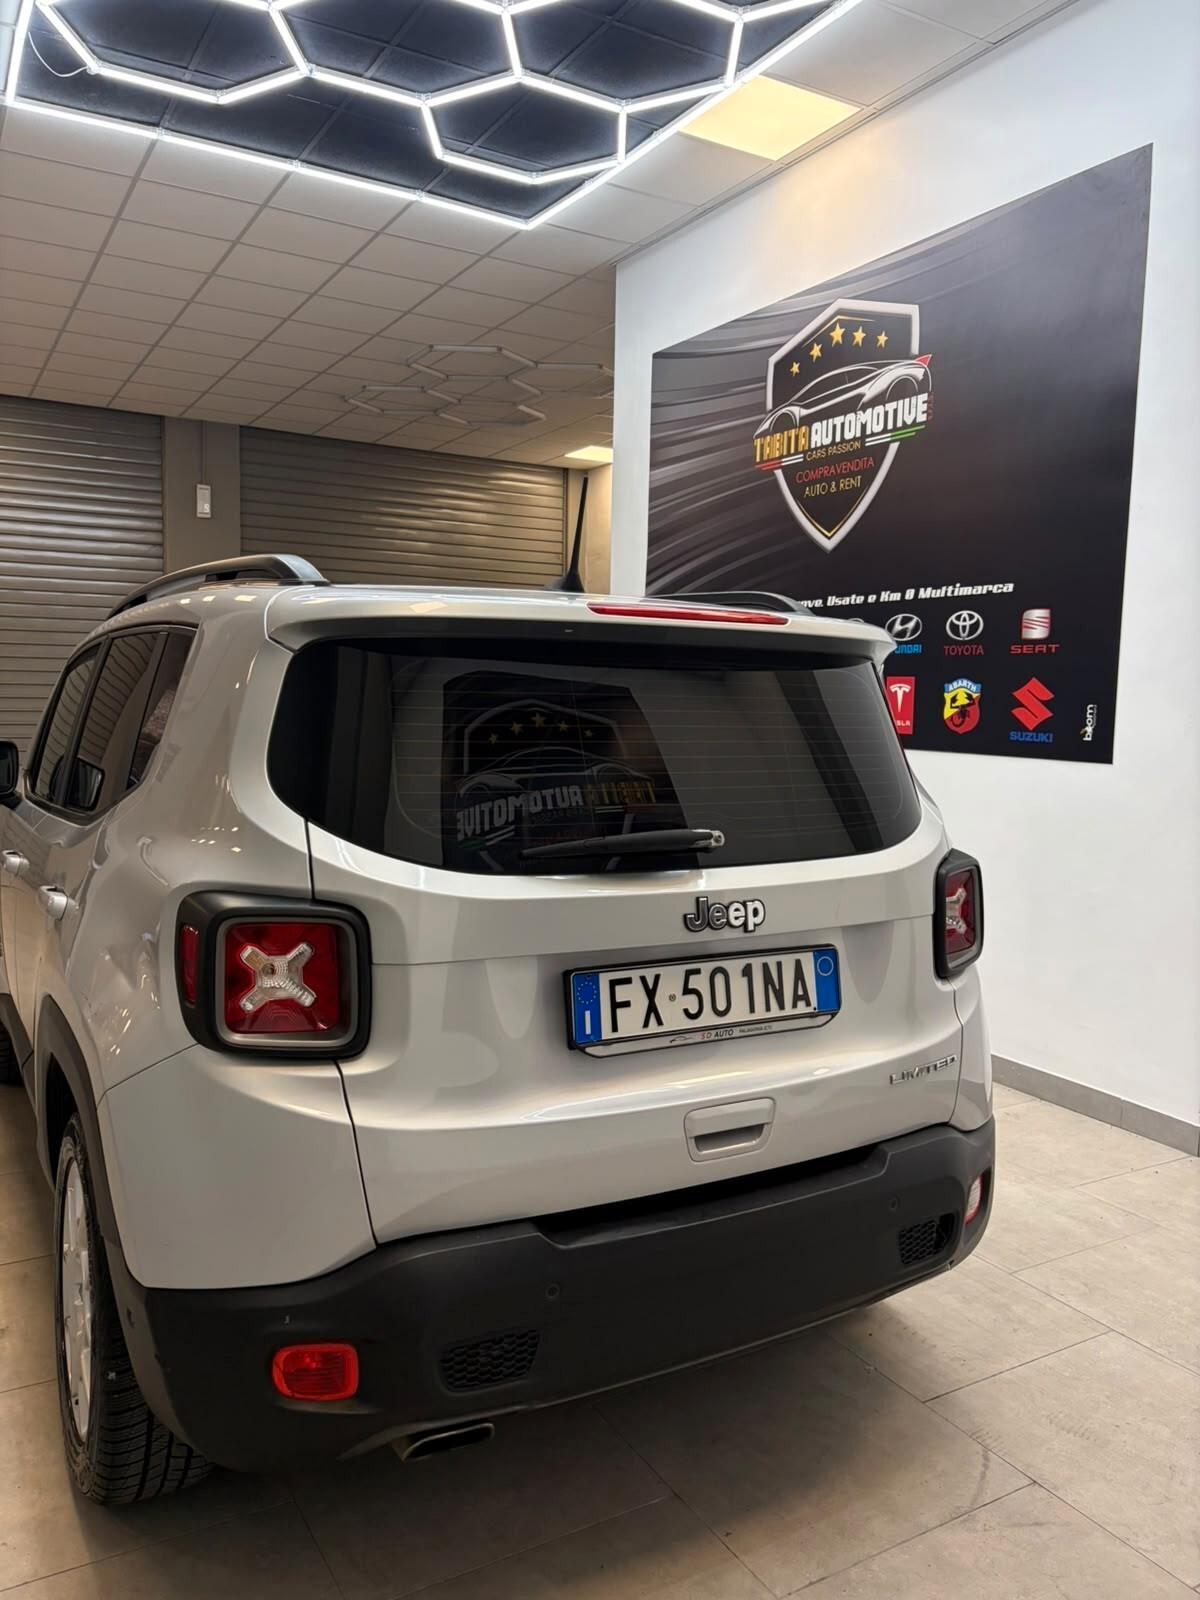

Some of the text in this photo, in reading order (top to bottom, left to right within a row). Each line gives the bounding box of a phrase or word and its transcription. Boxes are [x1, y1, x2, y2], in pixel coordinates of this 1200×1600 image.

[811, 393, 928, 449] AUTOMOTIVE
[805, 440, 862, 461] CARS PASSION
[795, 457, 875, 484] COMPRAVENDITA
[804, 476, 863, 498] AUTO & RENT
[826, 594, 865, 607] Usate
[867, 594, 877, 604] e
[880, 591, 902, 602] Km
[918, 582, 1014, 600] Multimarca
[943, 644, 985, 656] TOYOTA
[1010, 643, 1060, 654] SEAT
[948, 679, 977, 693] ABARTH
[1009, 731, 1053, 743] SUZUKI
[683, 896, 766, 933] Jeep
[608, 958, 812, 1033] FX 501NA
[714, 1028, 734, 1038] AUTO
[889, 1055, 957, 1085] LIMITED
